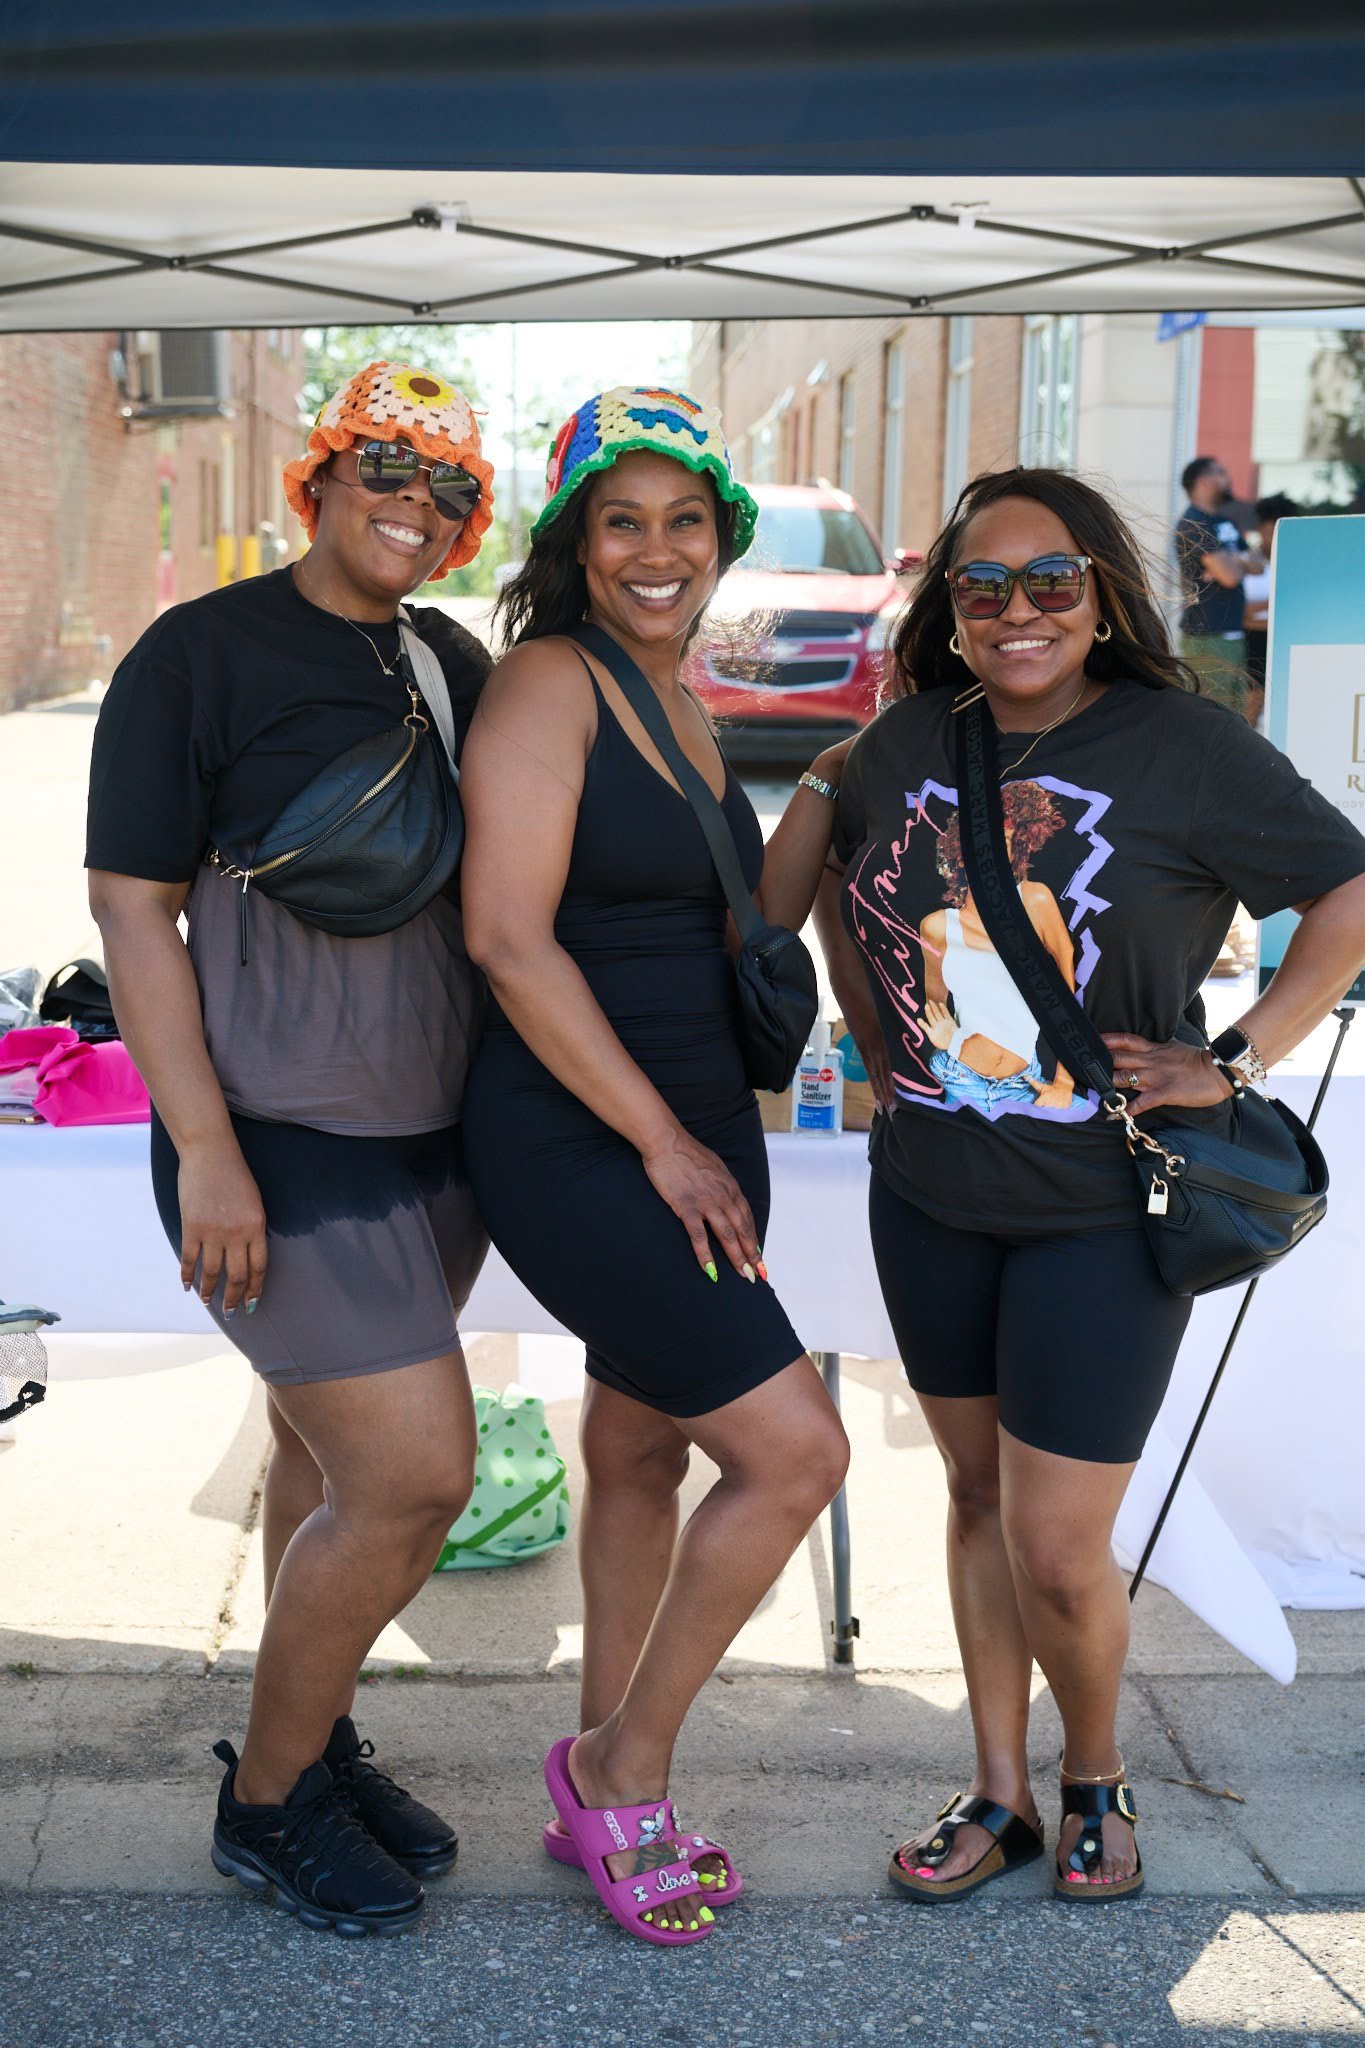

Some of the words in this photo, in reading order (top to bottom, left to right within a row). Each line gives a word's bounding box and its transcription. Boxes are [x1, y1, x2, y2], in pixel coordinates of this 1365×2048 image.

[968, 781, 990, 837] MARC
[801, 1082, 820, 1091] Hand
[801, 1091, 832, 1100] Sanitizer
[603, 1811, 628, 1850] crocs
[656, 1870, 691, 1892] love
